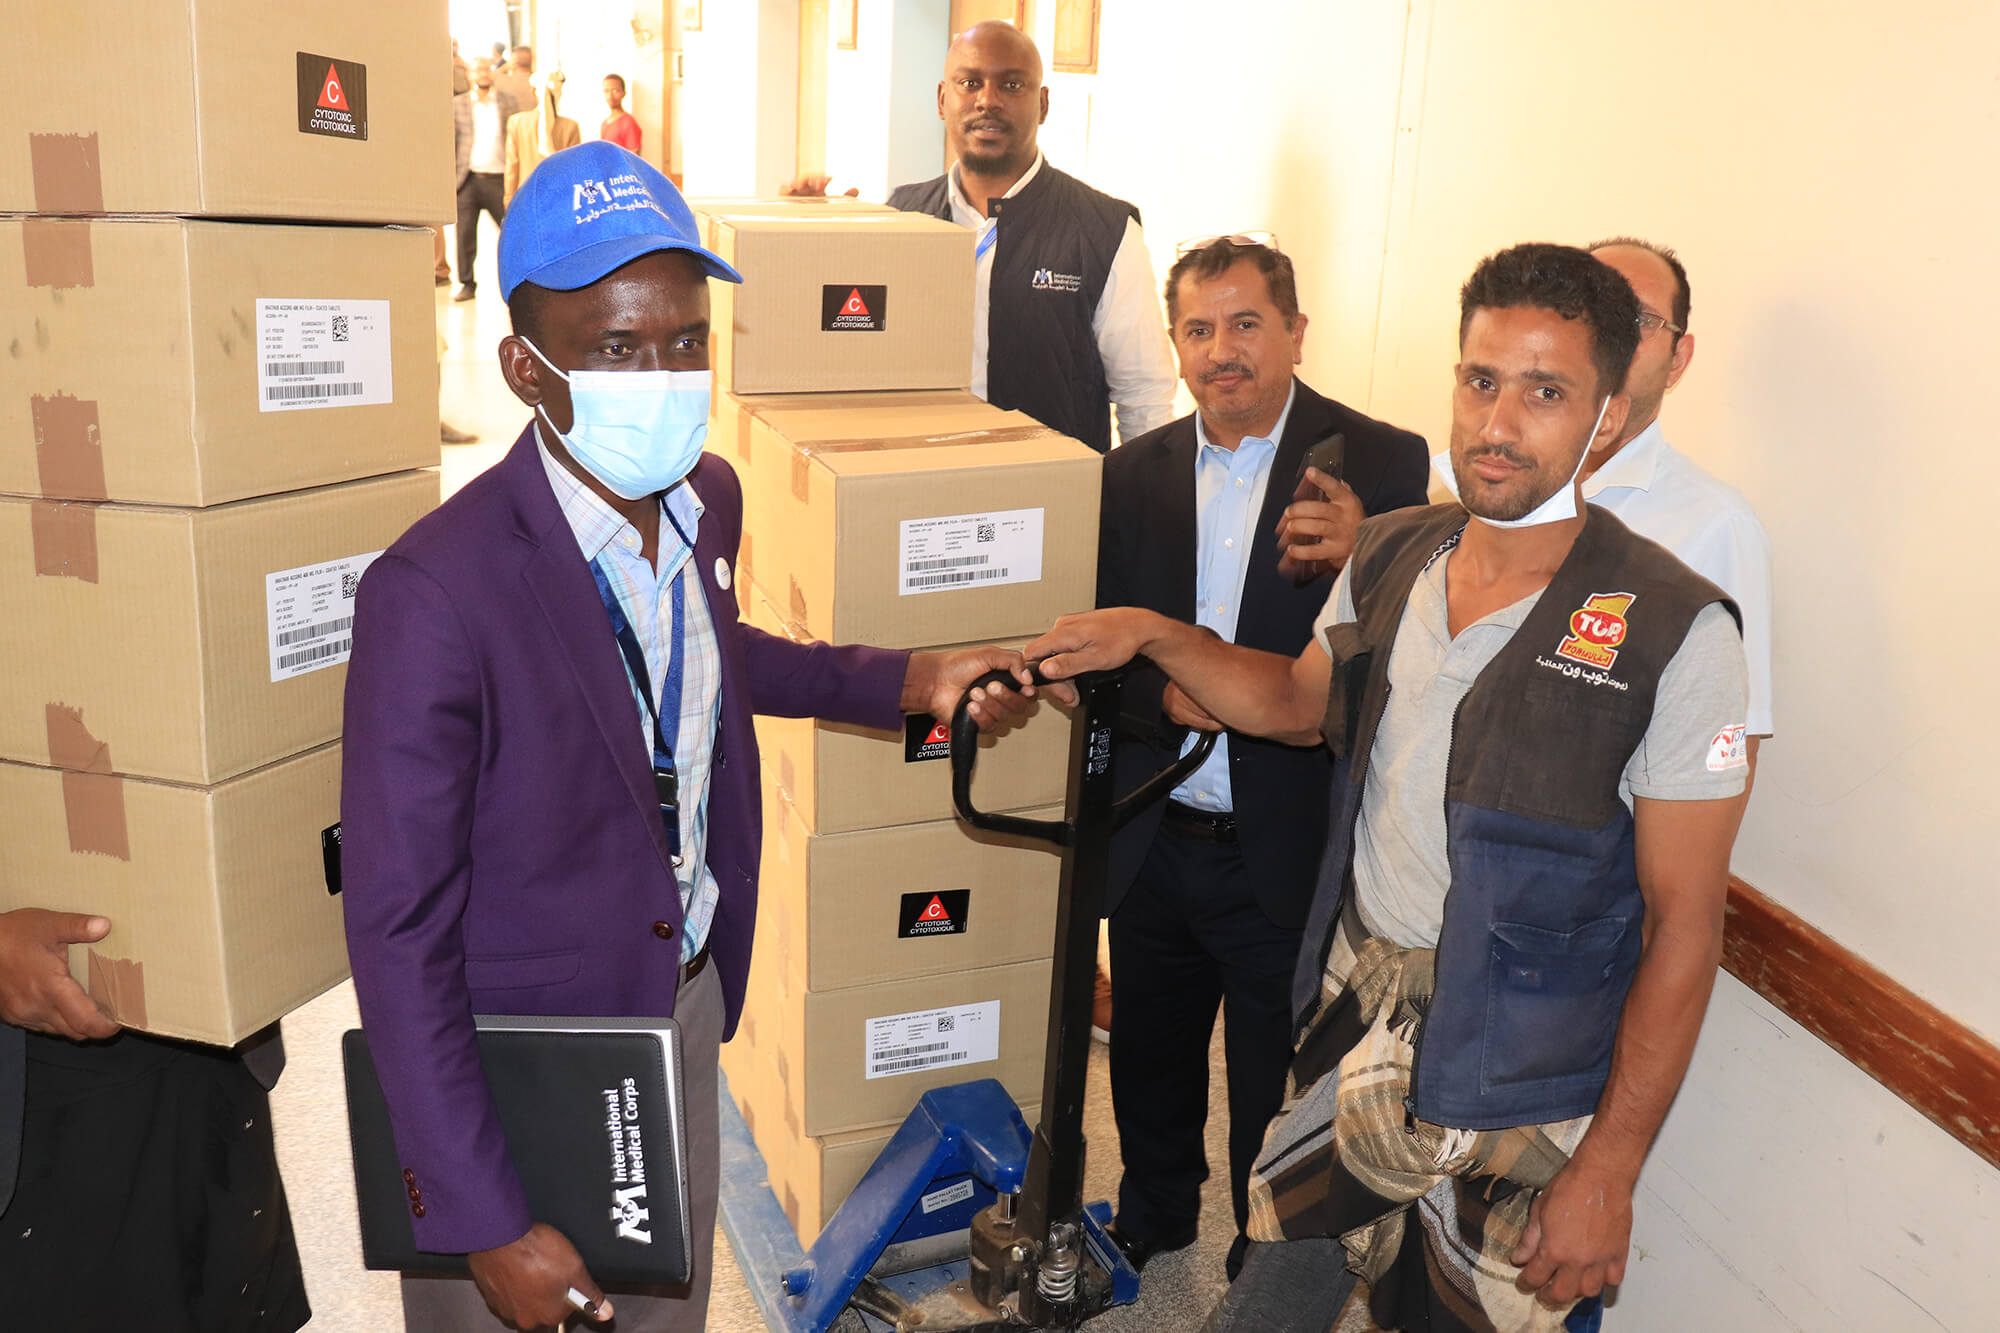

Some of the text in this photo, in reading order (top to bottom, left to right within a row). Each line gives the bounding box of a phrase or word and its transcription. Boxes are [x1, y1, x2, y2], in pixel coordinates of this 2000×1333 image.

[327, 80, 340, 103] C
[314, 108, 352, 123] CYTOTOXIC
[310, 119, 357, 134] CYTOTOXIQUE
[849, 297, 860, 312] C
[921, 742, 949, 751] CYTOTO
[928, 903, 941, 917] C
[910, 925, 956, 935] CYTOTOXIQUE
[914, 919, 952, 928] CYTOTOXIC
[604, 1088, 628, 1183] International
[623, 1077, 646, 1183] Medical Corps
